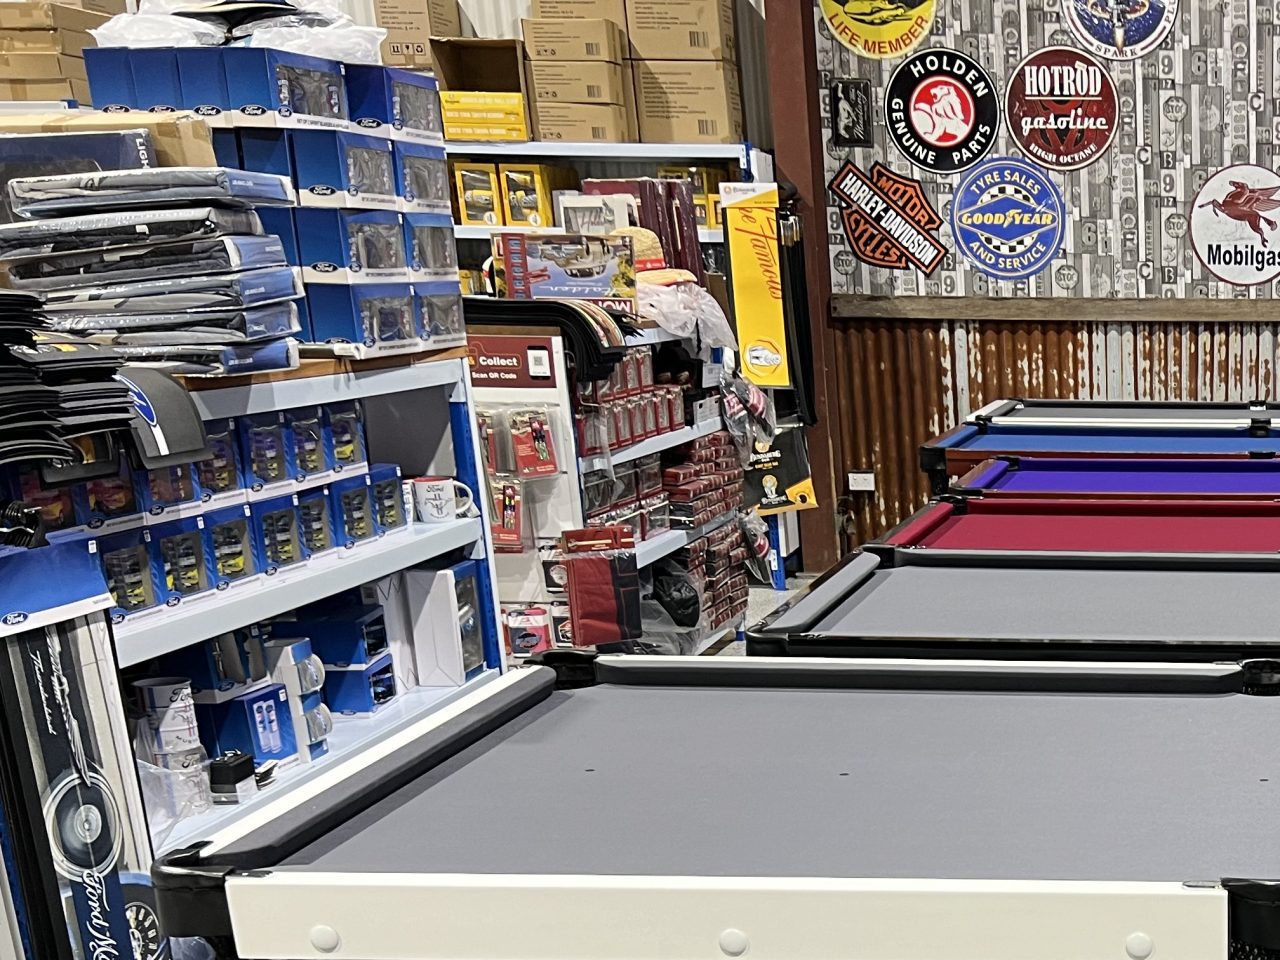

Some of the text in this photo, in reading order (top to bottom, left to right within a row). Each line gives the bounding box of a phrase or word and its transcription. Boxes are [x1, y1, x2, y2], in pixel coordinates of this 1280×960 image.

[828, 13, 929, 55] LIFE MEMBER
[1094, 44, 1138, 58] SPARK
[909, 55, 989, 98] HOLDEN
[1024, 65, 1102, 96] HOTROD
[891, 97, 937, 165] GENUINE
[1021, 108, 1109, 136] gasoline
[951, 124, 991, 165] PARTS
[1059, 143, 1098, 163] OCTANE
[969, 169, 1042, 195] TYRE SALES
[839, 172, 939, 267] HARLEY-DAVIDSON
[875, 177, 929, 227] MOTOR
[849, 212, 899, 262] CYCLES
[969, 240, 1047, 270] AND SERVICE
[471, 371, 518, 380] Scan QR Code
[479, 356, 519, 367] Collect
[83, 868, 110, 928] Ford
